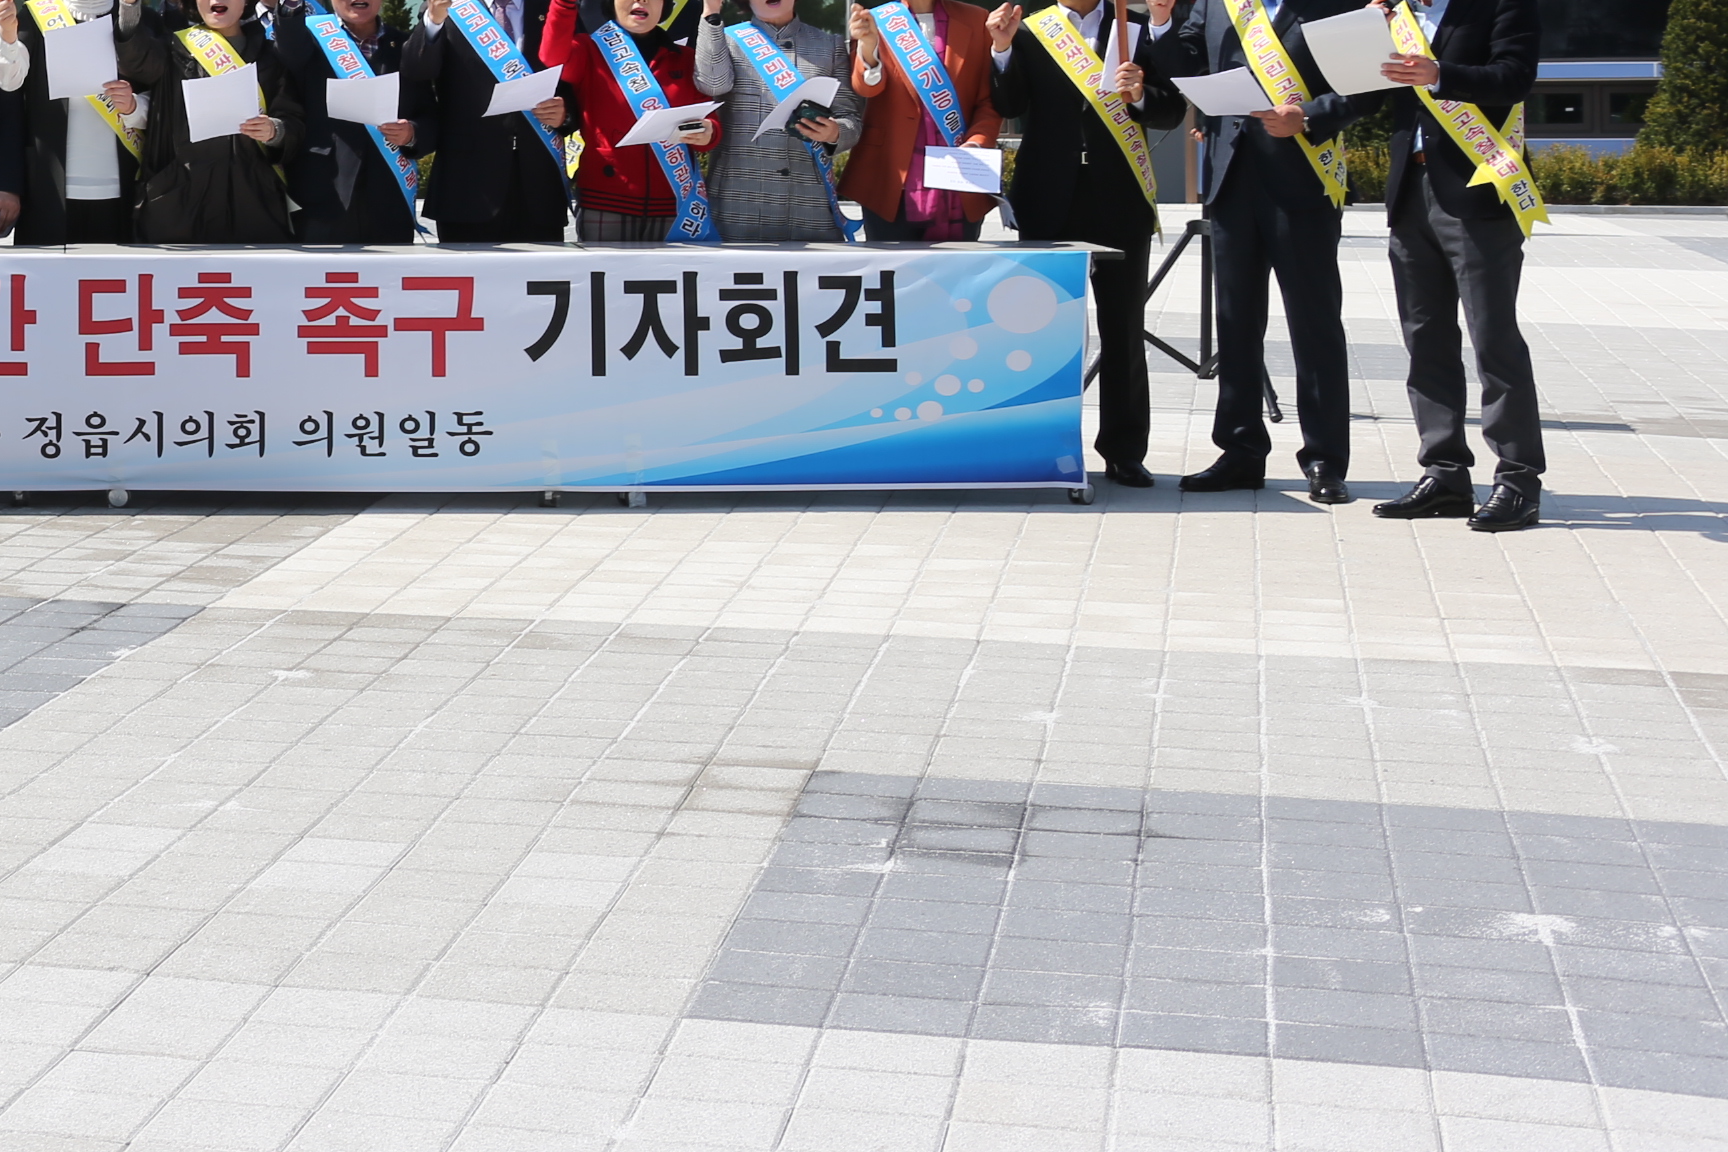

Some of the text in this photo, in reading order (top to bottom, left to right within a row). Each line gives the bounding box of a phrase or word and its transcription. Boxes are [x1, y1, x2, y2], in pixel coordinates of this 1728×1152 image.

[77, 272, 261, 379] 단축
[297, 271, 485, 378] 촉구
[524, 269, 899, 377] 기자회견
[21, 409, 268, 460] 정읍시의회
[292, 409, 495, 458] 의원일동
